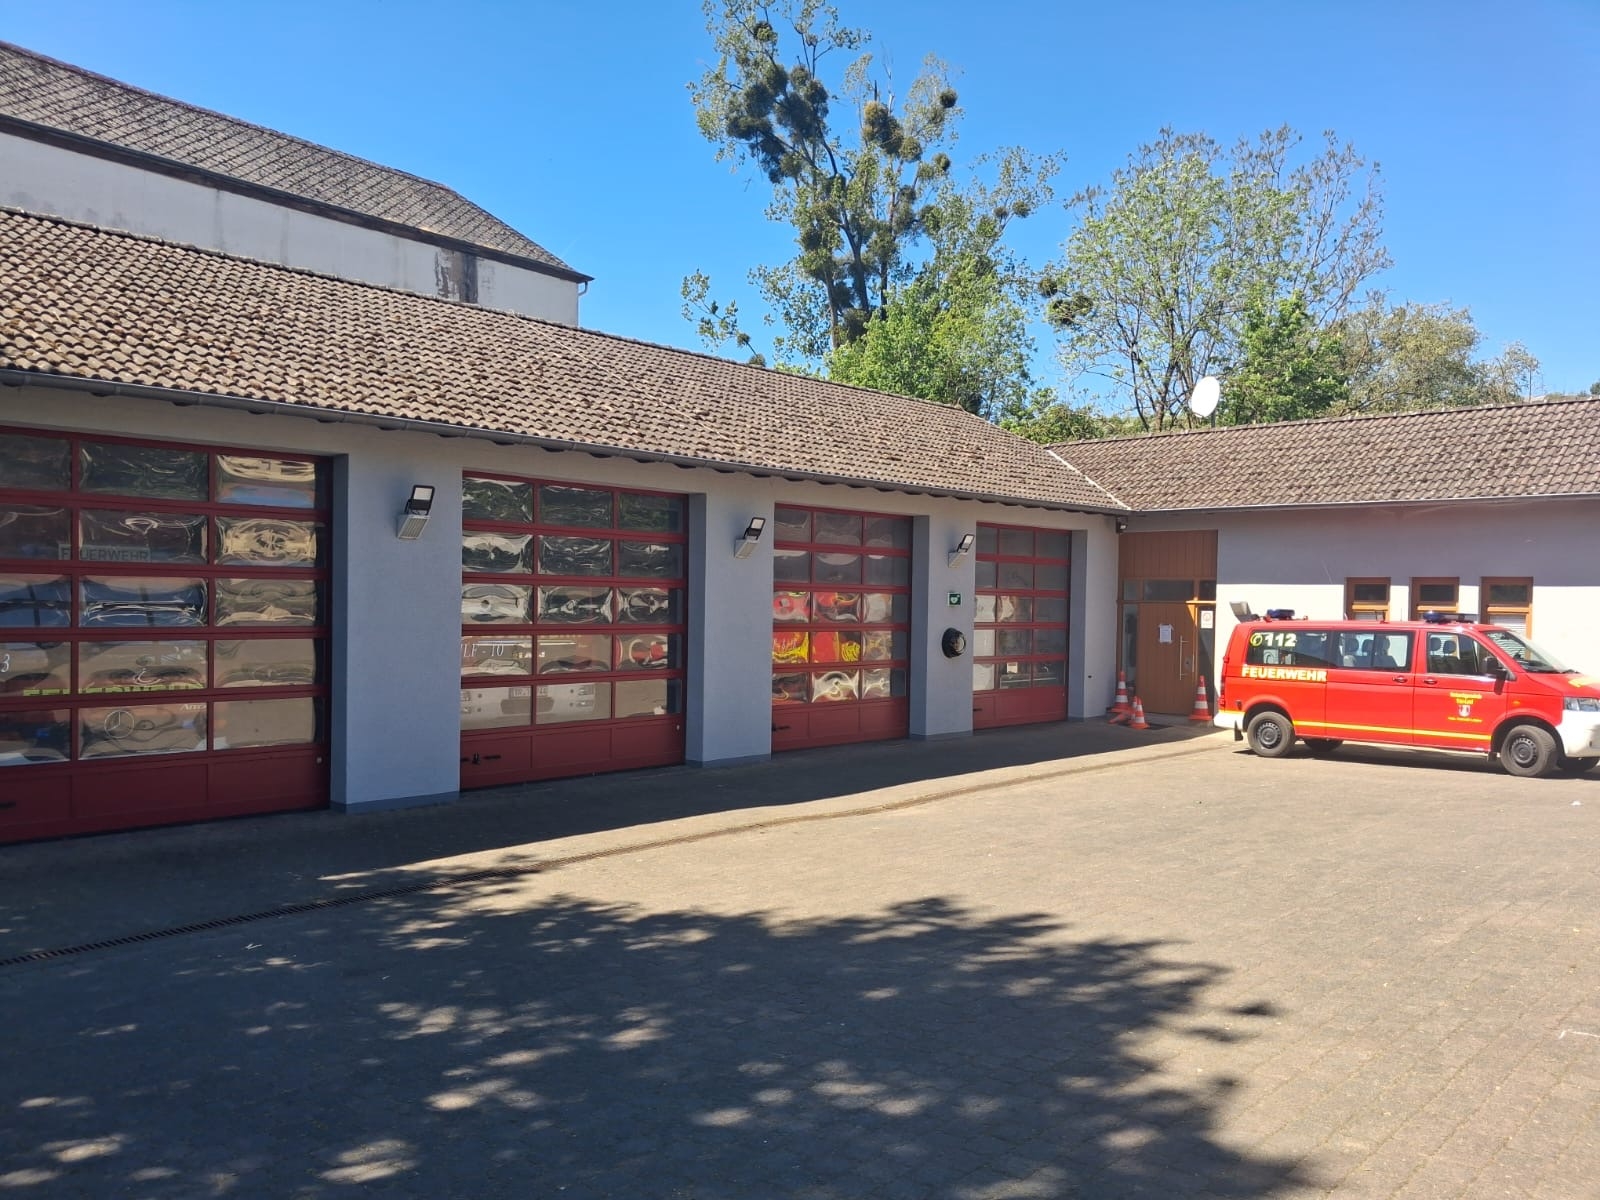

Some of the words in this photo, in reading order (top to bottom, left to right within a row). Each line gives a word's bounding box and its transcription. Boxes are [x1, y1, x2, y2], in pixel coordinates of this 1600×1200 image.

[62, 546, 149, 561] FUERWEHR
[1264, 632, 1297, 647] 112
[461, 643, 479, 658] LF
[1242, 665, 1327, 682] FEUERWEHR
